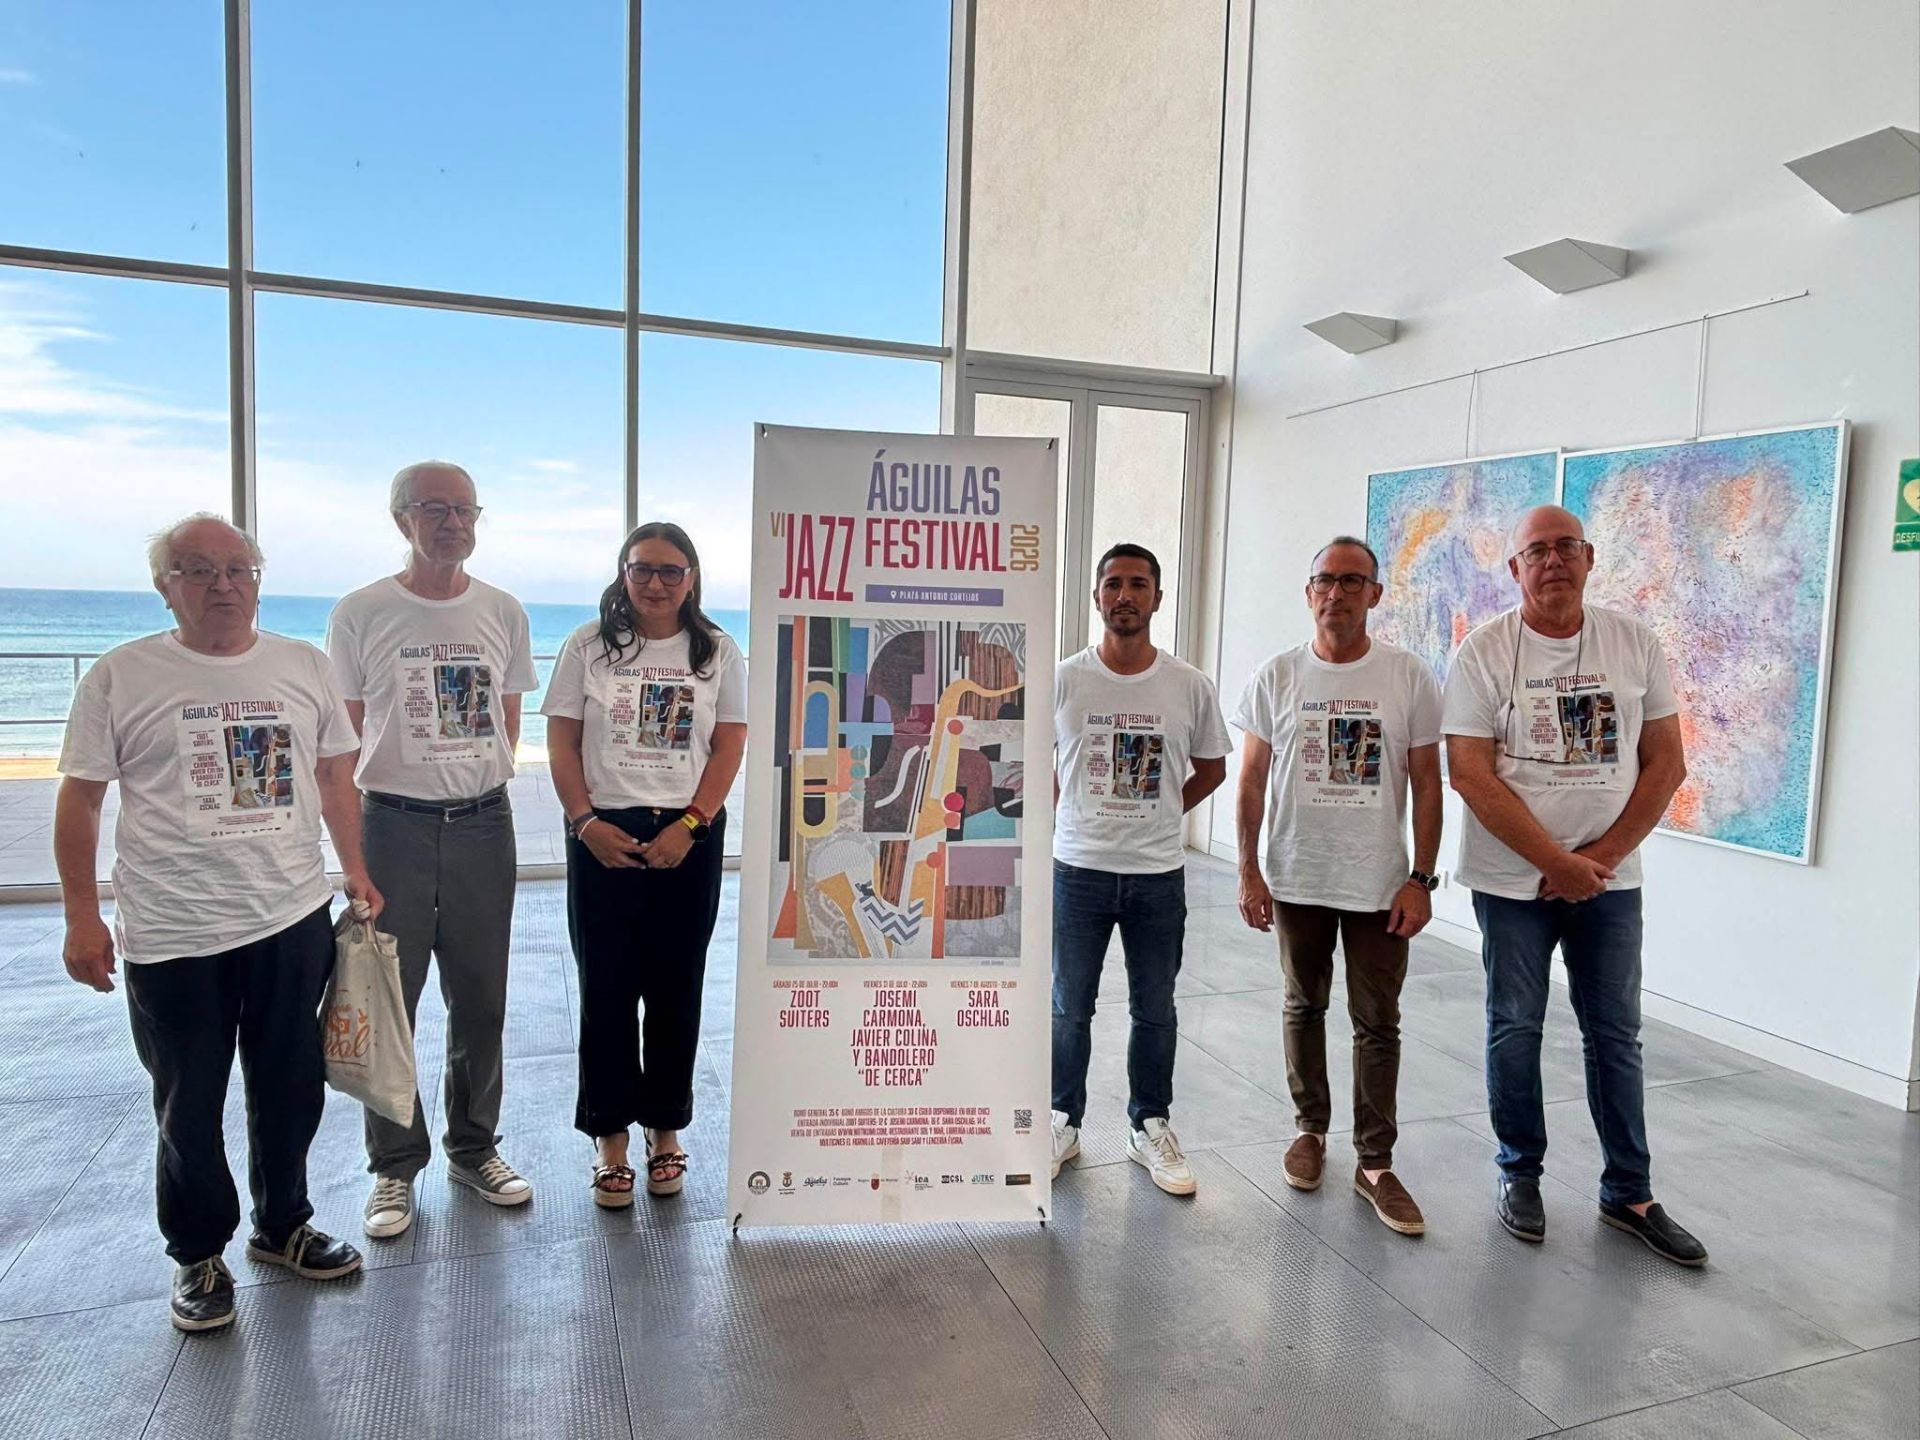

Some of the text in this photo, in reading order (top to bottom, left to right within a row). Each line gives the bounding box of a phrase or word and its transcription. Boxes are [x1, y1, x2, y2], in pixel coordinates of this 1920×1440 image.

[866, 449, 1000, 516] ÁGUILAS
[770, 512, 1007, 602] VI JAZZ FESTIVAL
[1010, 524, 1040, 573] 2026
[899, 590, 918, 600] PLAZA
[221, 702, 242, 722] JAZZ
[241, 700, 278, 713] FESTIVAL
[790, 990, 820, 1008] ZOOT
[873, 989, 917, 1008] JOSEMI
[968, 990, 999, 1008] SARA
[780, 1009, 829, 1028] SUITERS
[863, 1009, 926, 1028] CARMONA,
[957, 1009, 1009, 1027] OSCHLAG
[850, 1028, 938, 1047] JAVIER COLINA
[853, 1048, 935, 1067] Y BANDOLERO
